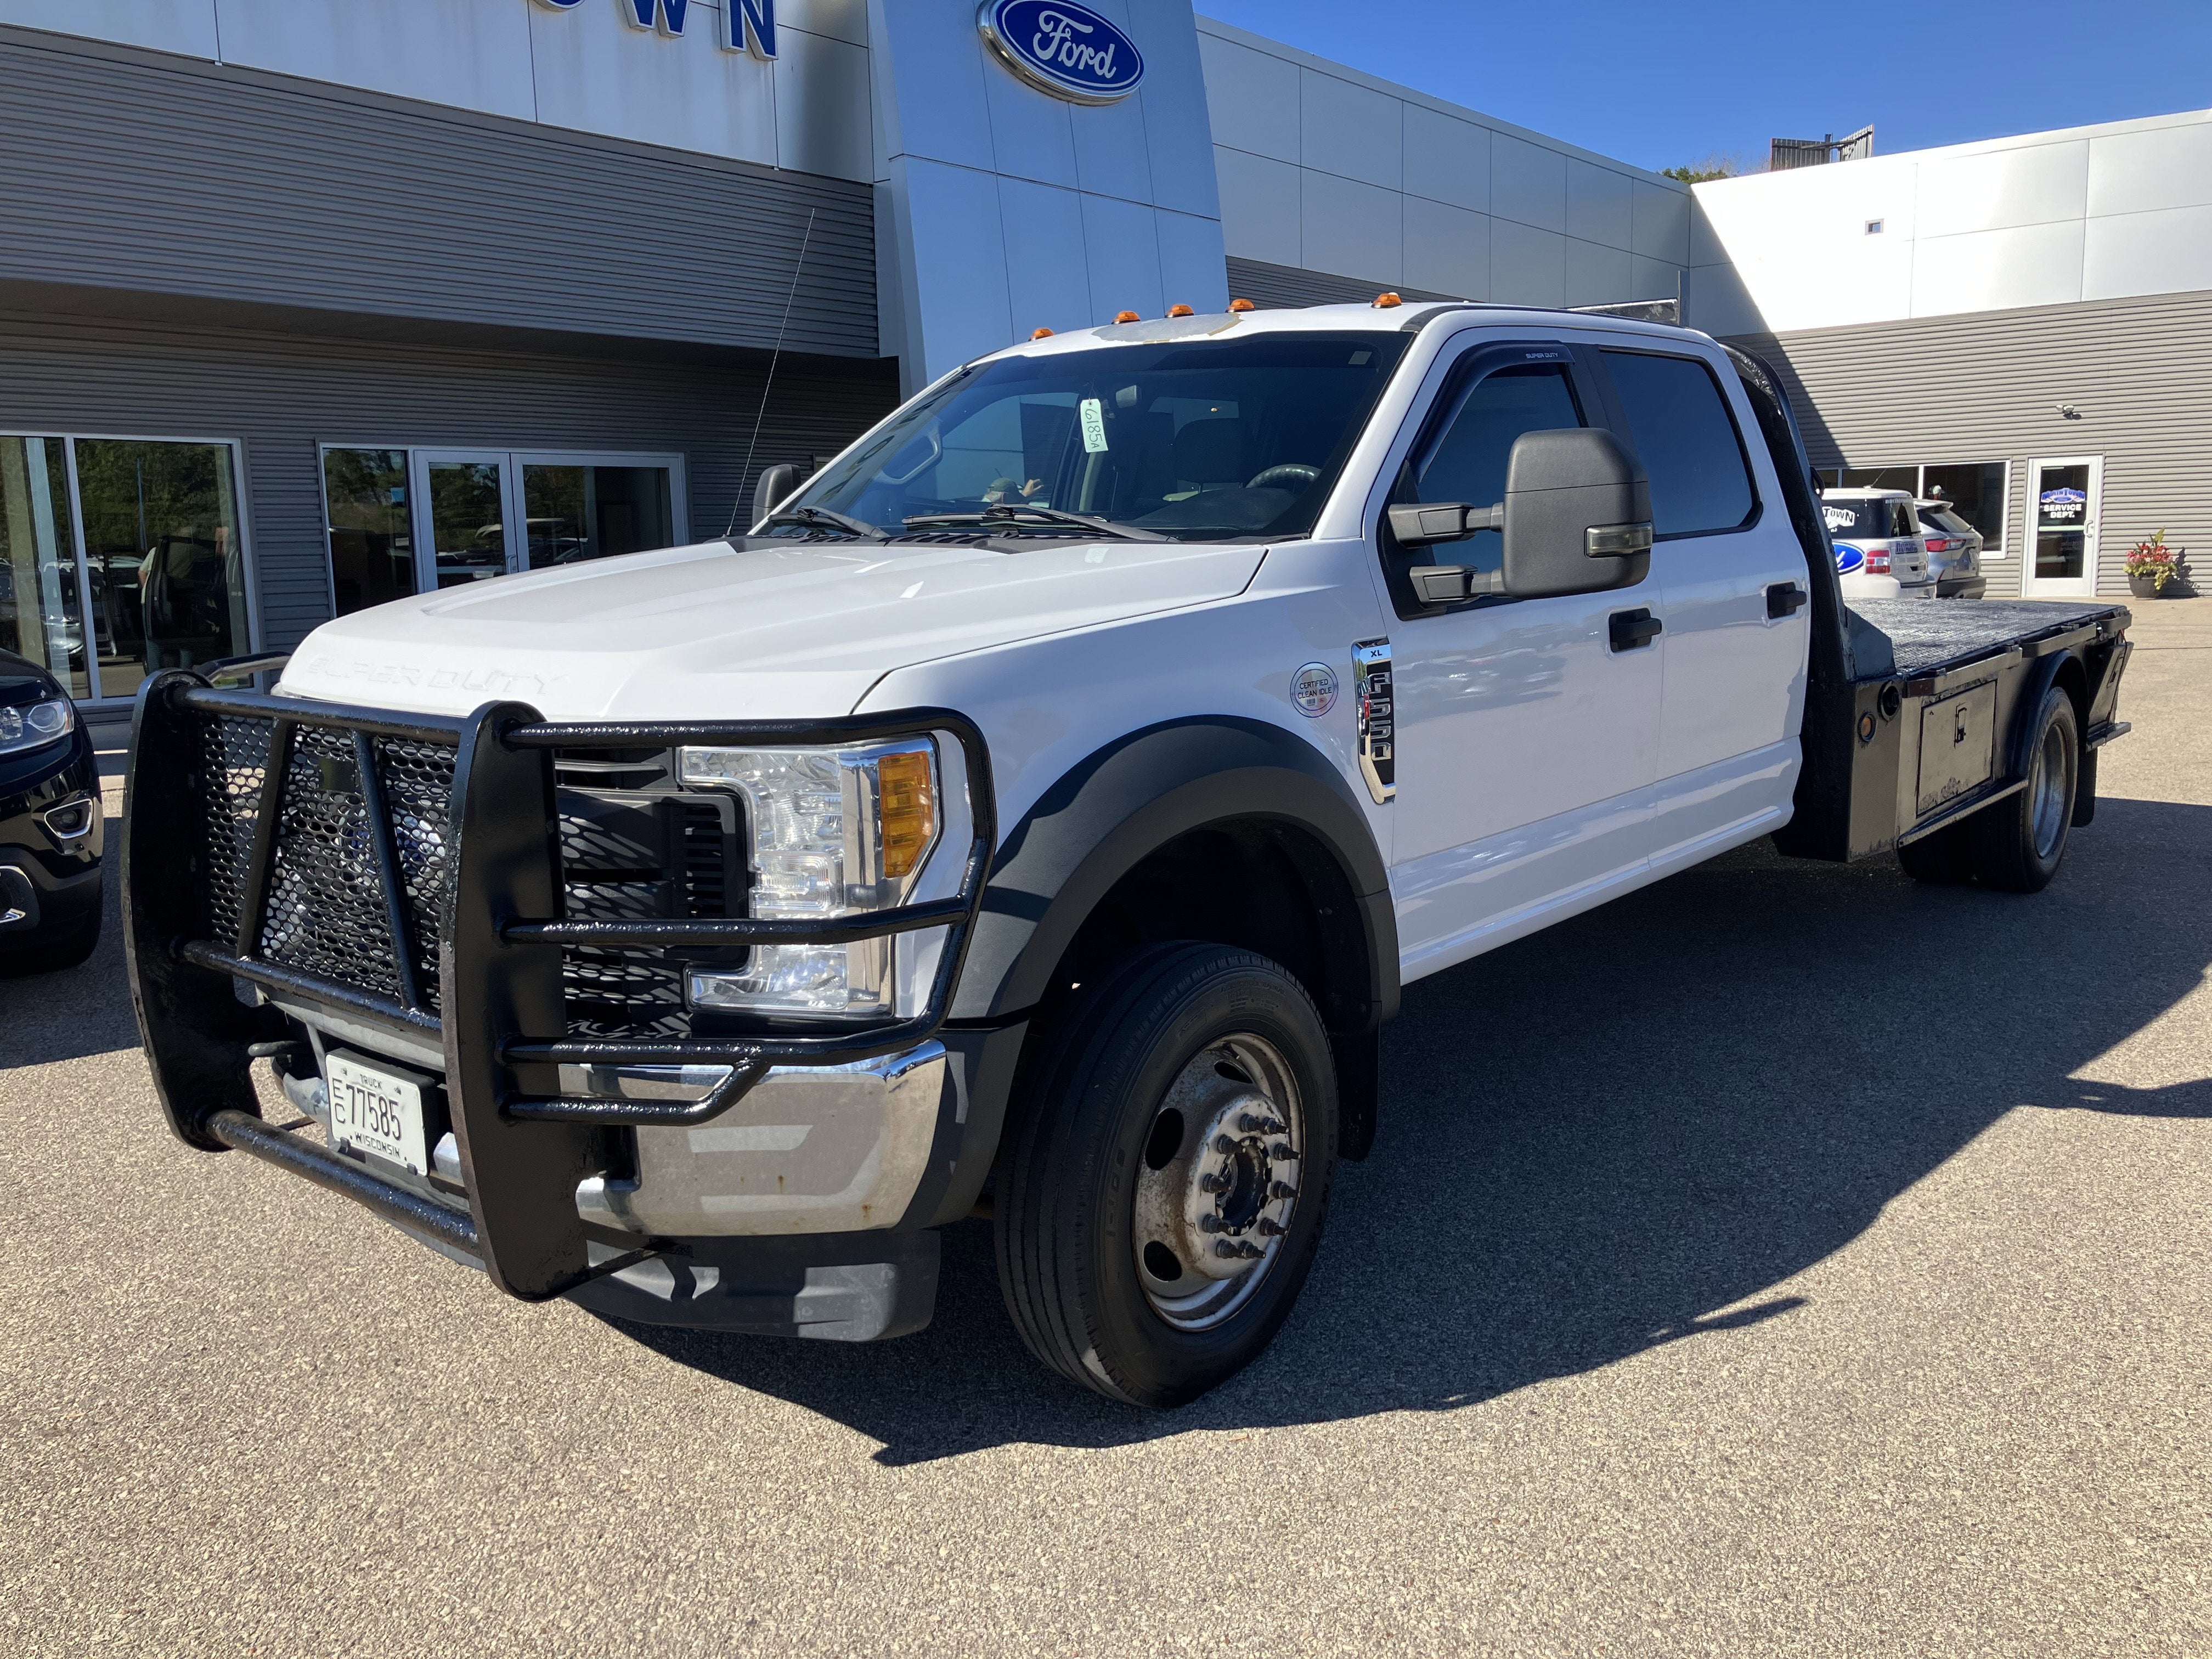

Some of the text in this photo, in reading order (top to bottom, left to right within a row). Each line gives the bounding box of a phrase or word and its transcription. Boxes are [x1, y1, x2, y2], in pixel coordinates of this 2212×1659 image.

[1033, 10, 1116, 78] Ford
[1085, 409, 1103, 449] 6185A
[2044, 504, 2082, 512] SERVICE
[428, 668, 568, 695] DUTY
[1297, 687, 1332, 699] CLEAN IDLE
[1299, 679, 1328, 690] CERTIFIED
[359, 1073, 382, 1089] TRUCK
[346, 1083, 403, 1142] 77585
[354, 1131, 401, 1159] WISCONSIN
